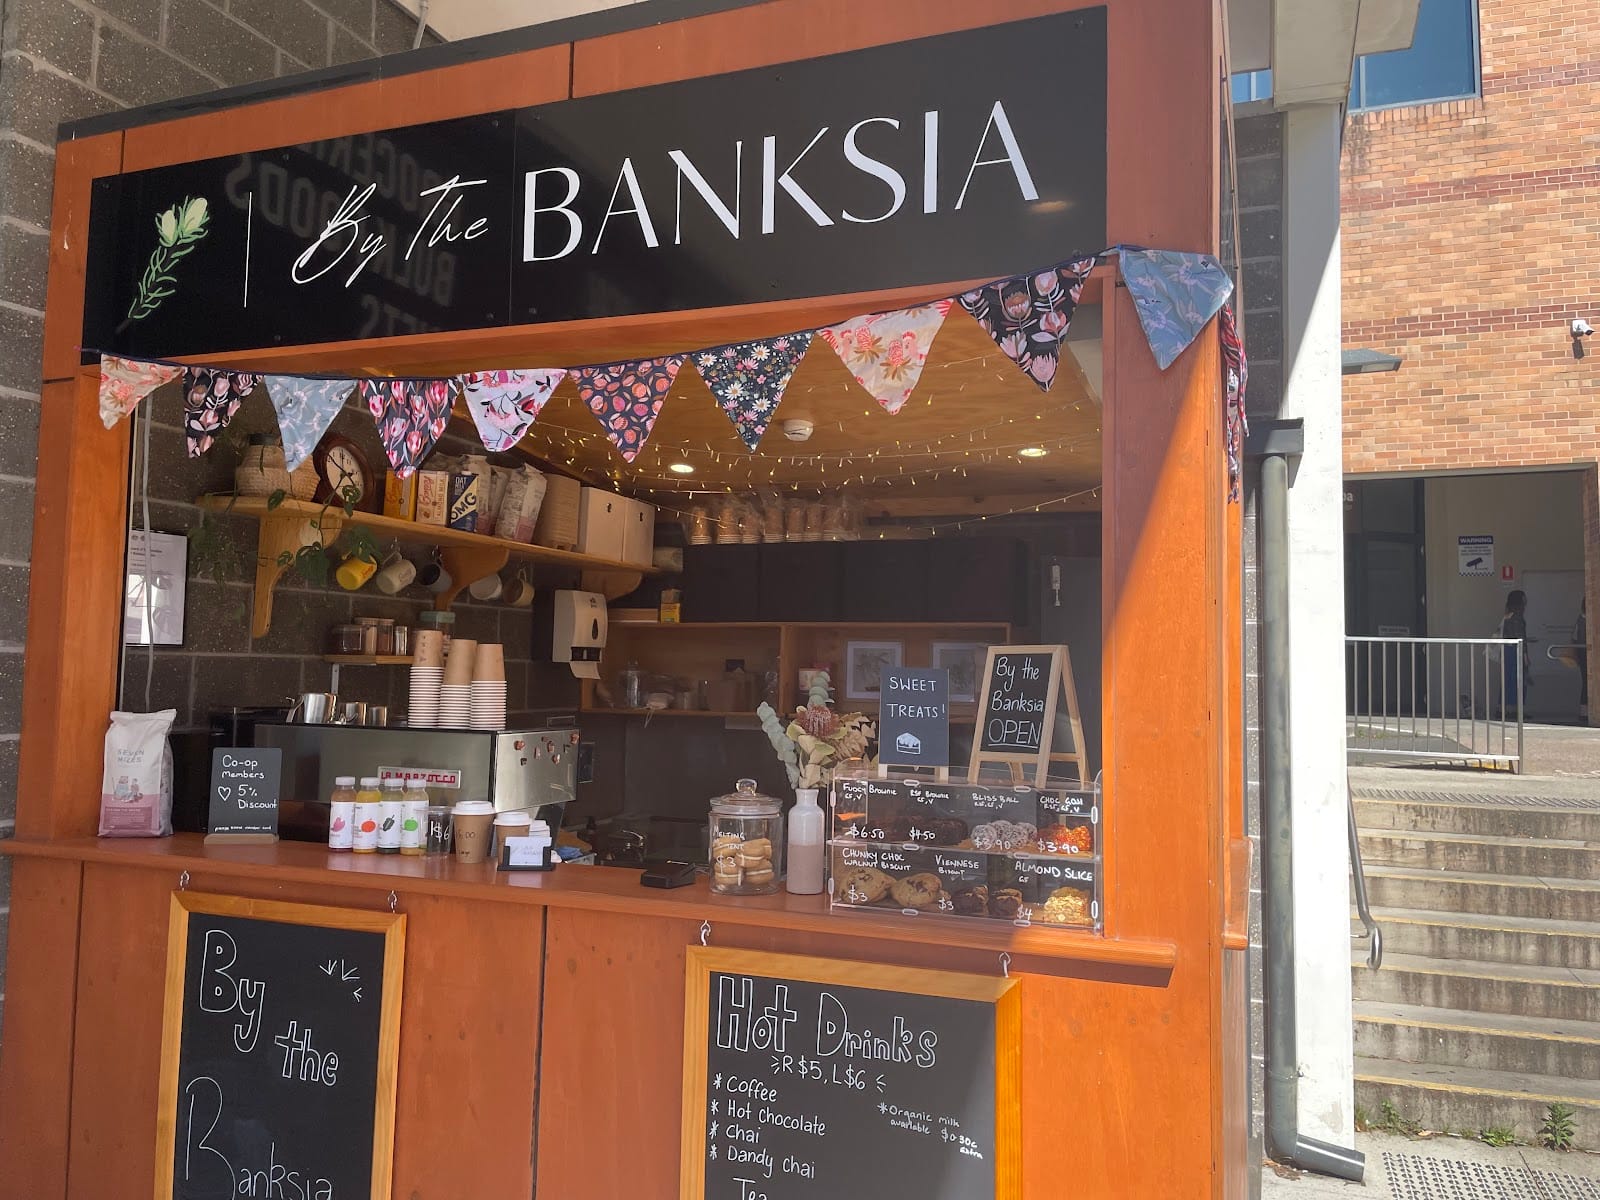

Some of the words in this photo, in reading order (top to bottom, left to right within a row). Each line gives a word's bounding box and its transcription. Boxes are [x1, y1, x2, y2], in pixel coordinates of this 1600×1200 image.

[291, 184, 378, 288] By
[405, 175, 489, 261] The
[522, 100, 1041, 263] BANKSIA
[996, 656, 1016, 692] By
[1022, 657, 1040, 680] the
[889, 676, 937, 692] SWEET
[991, 690, 1044, 713] Banksia
[886, 703, 945, 719] TREATS!
[988, 718, 1042, 745] OPEN
[222, 754, 258, 769] Co-op
[381, 771, 391, 780] LA
[238, 784, 258, 796] 5%
[238, 799, 278, 809] Discount
[850, 823, 885, 839] $6.50
[842, 847, 878, 863] CHUNKY
[881, 852, 905, 861] CHOC
[1037, 838, 1079, 854] $3.90
[844, 859, 878, 868] WALNUT
[1015, 861, 1061, 878] ALMOND
[1064, 868, 1093, 882] SLICE
[848, 885, 868, 903] $3
[938, 897, 954, 911] $3
[1016, 904, 1033, 920] $4
[199, 929, 266, 1053] By
[716, 975, 798, 1053] Hot
[816, 992, 938, 1068] Drinks
[274, 1020, 339, 1086] the
[782, 1055, 793, 1074] R
[832, 1063, 842, 1085] L
[843, 1063, 866, 1090] $6
[726, 1075, 777, 1102] Coffee
[727, 1099, 752, 1120] Hot
[890, 1118, 931, 1134] available
[938, 1116, 960, 1128] milk
[186, 1076, 333, 1200] Banksia
[725, 1123, 761, 1143] Chai
[727, 1145, 773, 1178] Dandy
